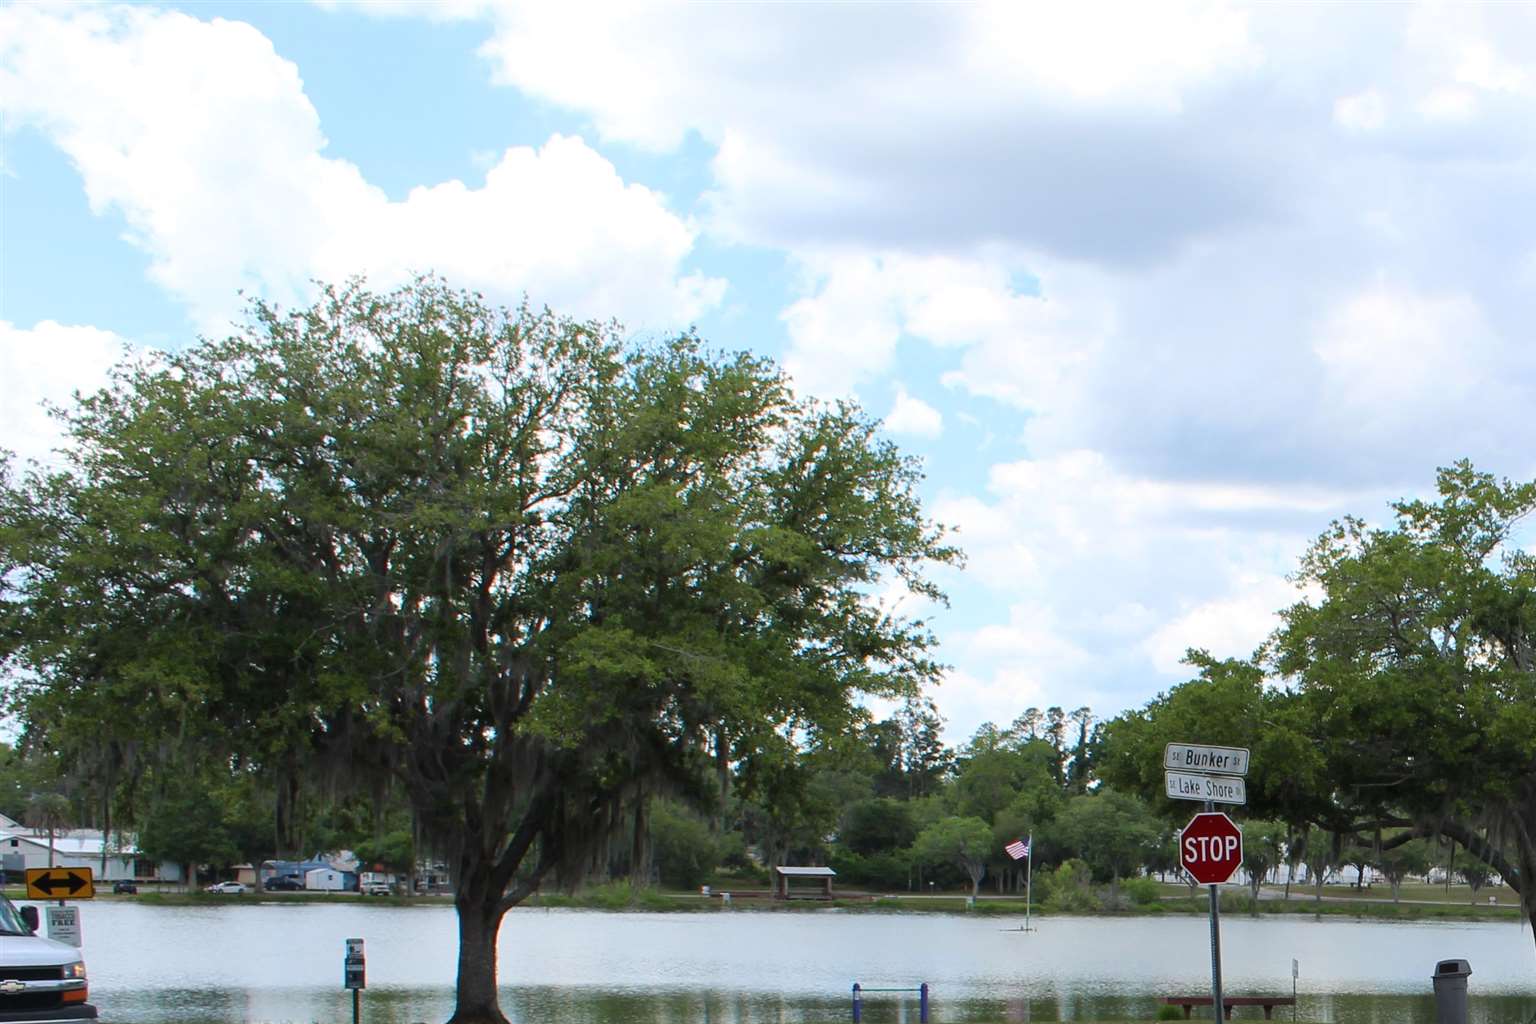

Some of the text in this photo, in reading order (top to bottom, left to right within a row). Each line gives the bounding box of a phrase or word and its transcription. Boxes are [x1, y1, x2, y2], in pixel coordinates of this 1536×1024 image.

[1186, 749, 1229, 768] Bunker
[1179, 777, 1200, 794] Lake
[1206, 780, 1233, 798] Shore
[1185, 836, 1238, 864] STOP
